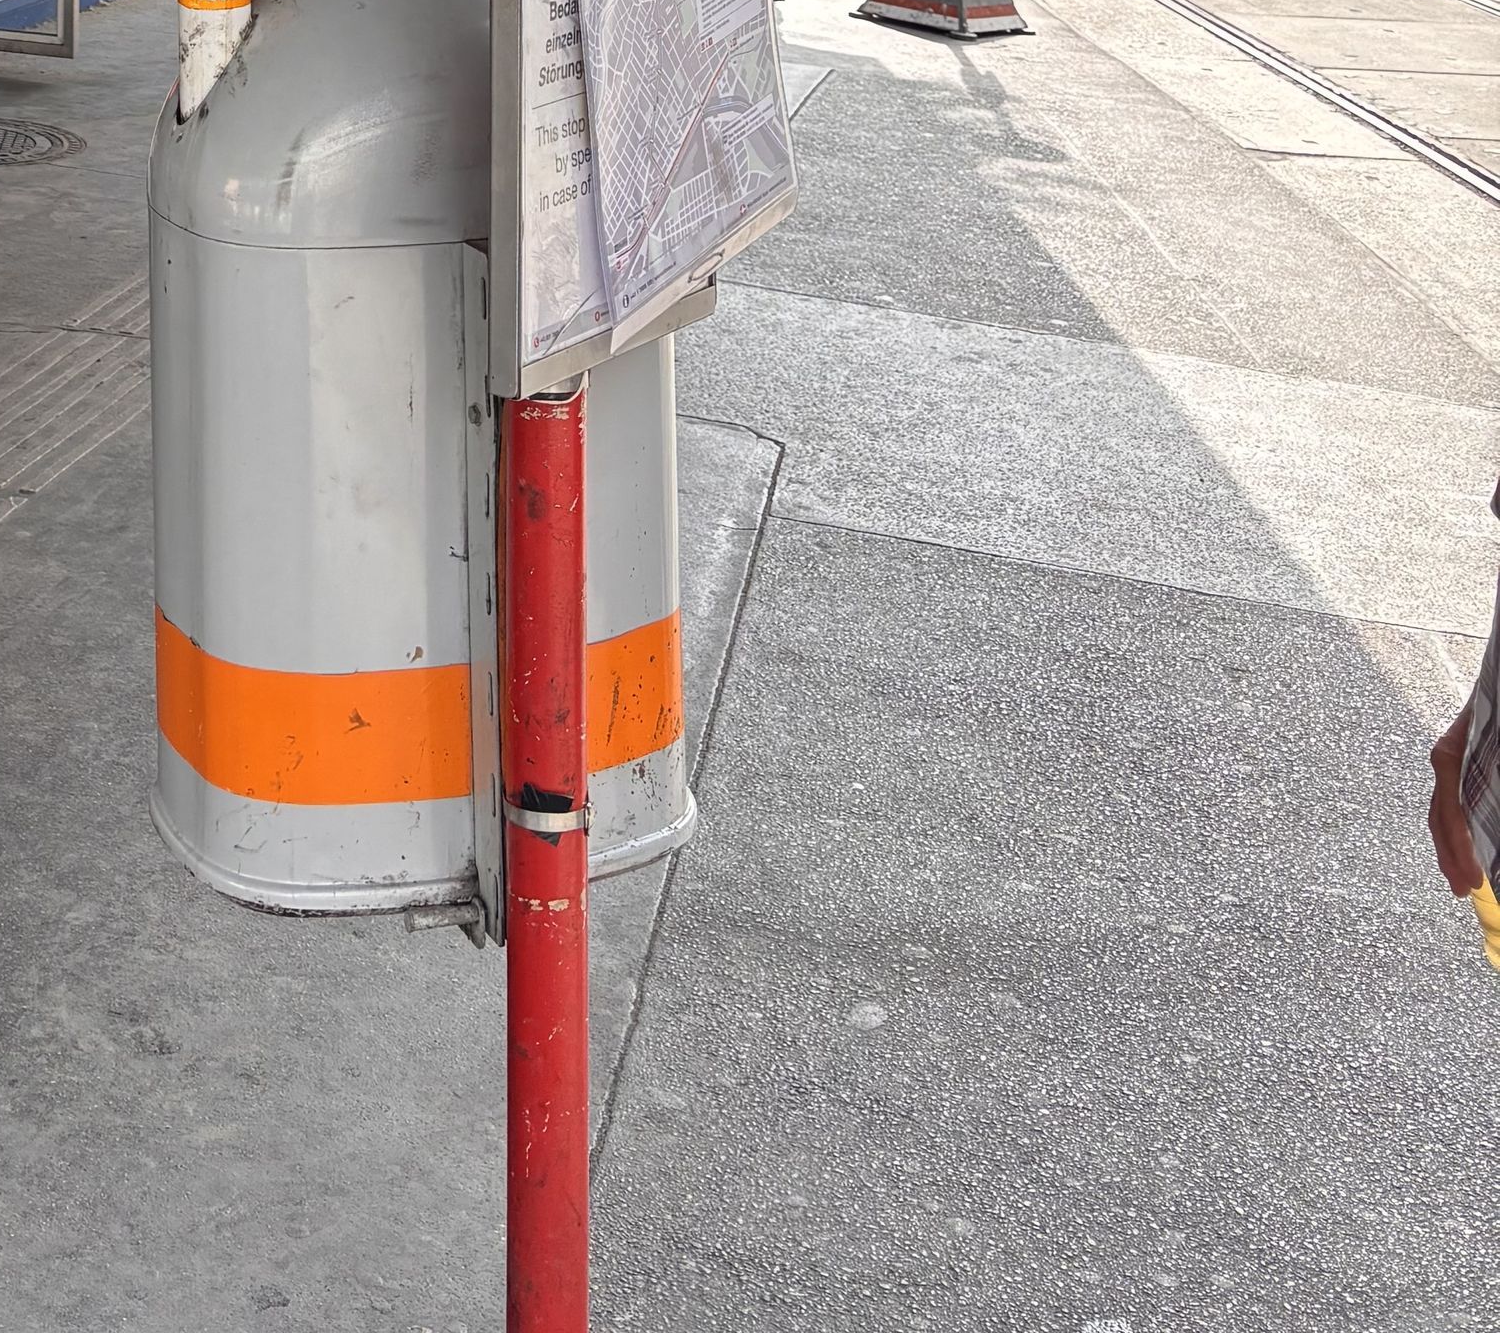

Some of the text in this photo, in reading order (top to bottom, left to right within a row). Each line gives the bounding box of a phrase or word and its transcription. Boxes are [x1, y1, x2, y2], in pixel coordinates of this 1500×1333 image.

[535, 116, 586, 147] This stop
[555, 152, 569, 177] by
[539, 191, 550, 212] in
[552, 184, 578, 208] case
